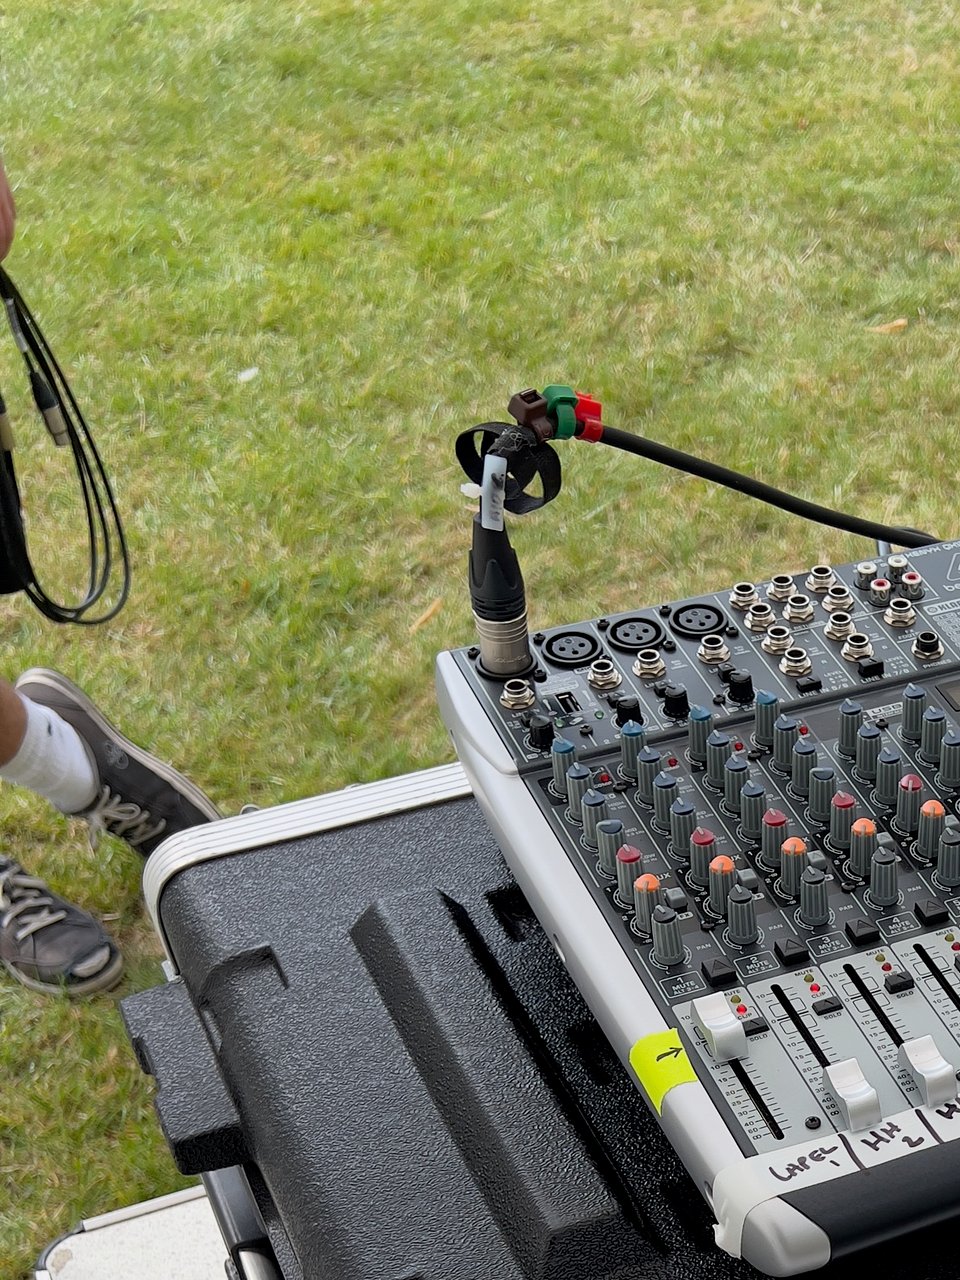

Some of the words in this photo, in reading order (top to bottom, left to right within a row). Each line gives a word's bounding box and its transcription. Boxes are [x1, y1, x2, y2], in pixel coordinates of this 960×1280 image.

[657, 872, 671, 880] UX
[888, 921, 910, 930] MUTE
[818, 941, 841, 950] MUTE
[746, 960, 769, 970] MUTE
[672, 982, 695, 991] MUTE
[896, 991, 914, 999] SOLO
[824, 1012, 842, 1020] SOLO
[860, 1122, 902, 1151] HH
[902, 1135, 925, 1148] 2
[769, 1146, 838, 1182] LAPEL
